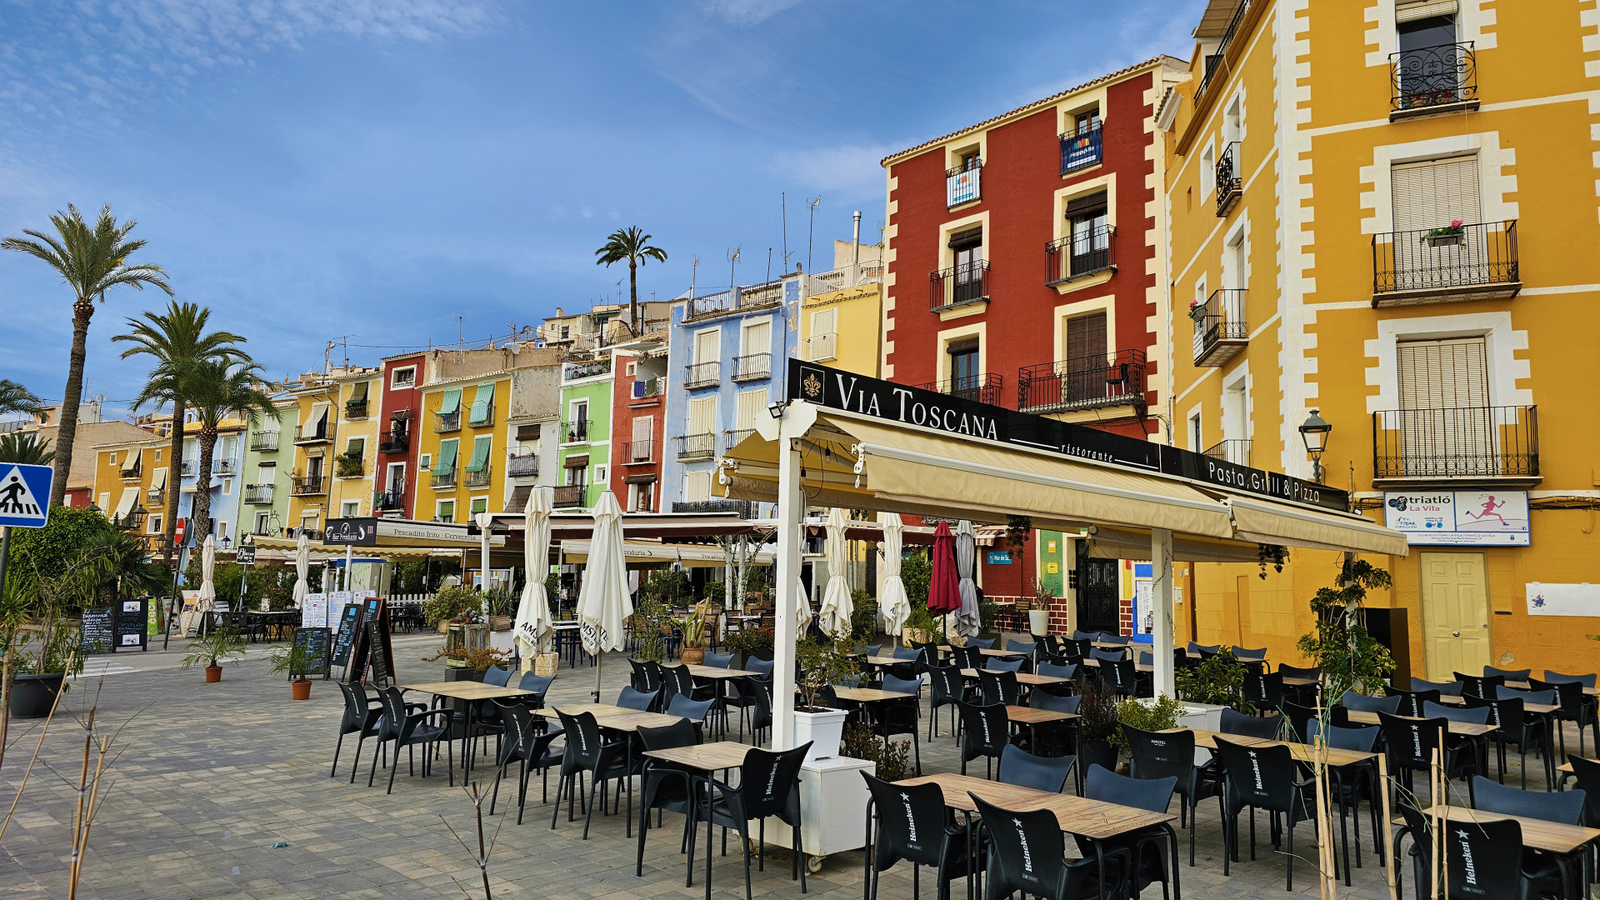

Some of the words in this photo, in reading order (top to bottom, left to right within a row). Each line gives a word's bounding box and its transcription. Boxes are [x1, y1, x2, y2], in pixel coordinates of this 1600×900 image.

[835, 373, 881, 417] VIA
[892, 387, 998, 441] TOSCANA
[1061, 443, 1113, 463] ristorante
[1283, 479, 1291, 496] &
[1409, 495, 1451, 504] triatló
[393, 528, 425, 537] Pescadito
[765, 762, 779, 795] Heineken
[1250, 758, 1264, 790] Heineken
[903, 803, 918, 842] Heineken
[1016, 829, 1033, 873] Heineken
[1458, 840, 1477, 885] Heineken
